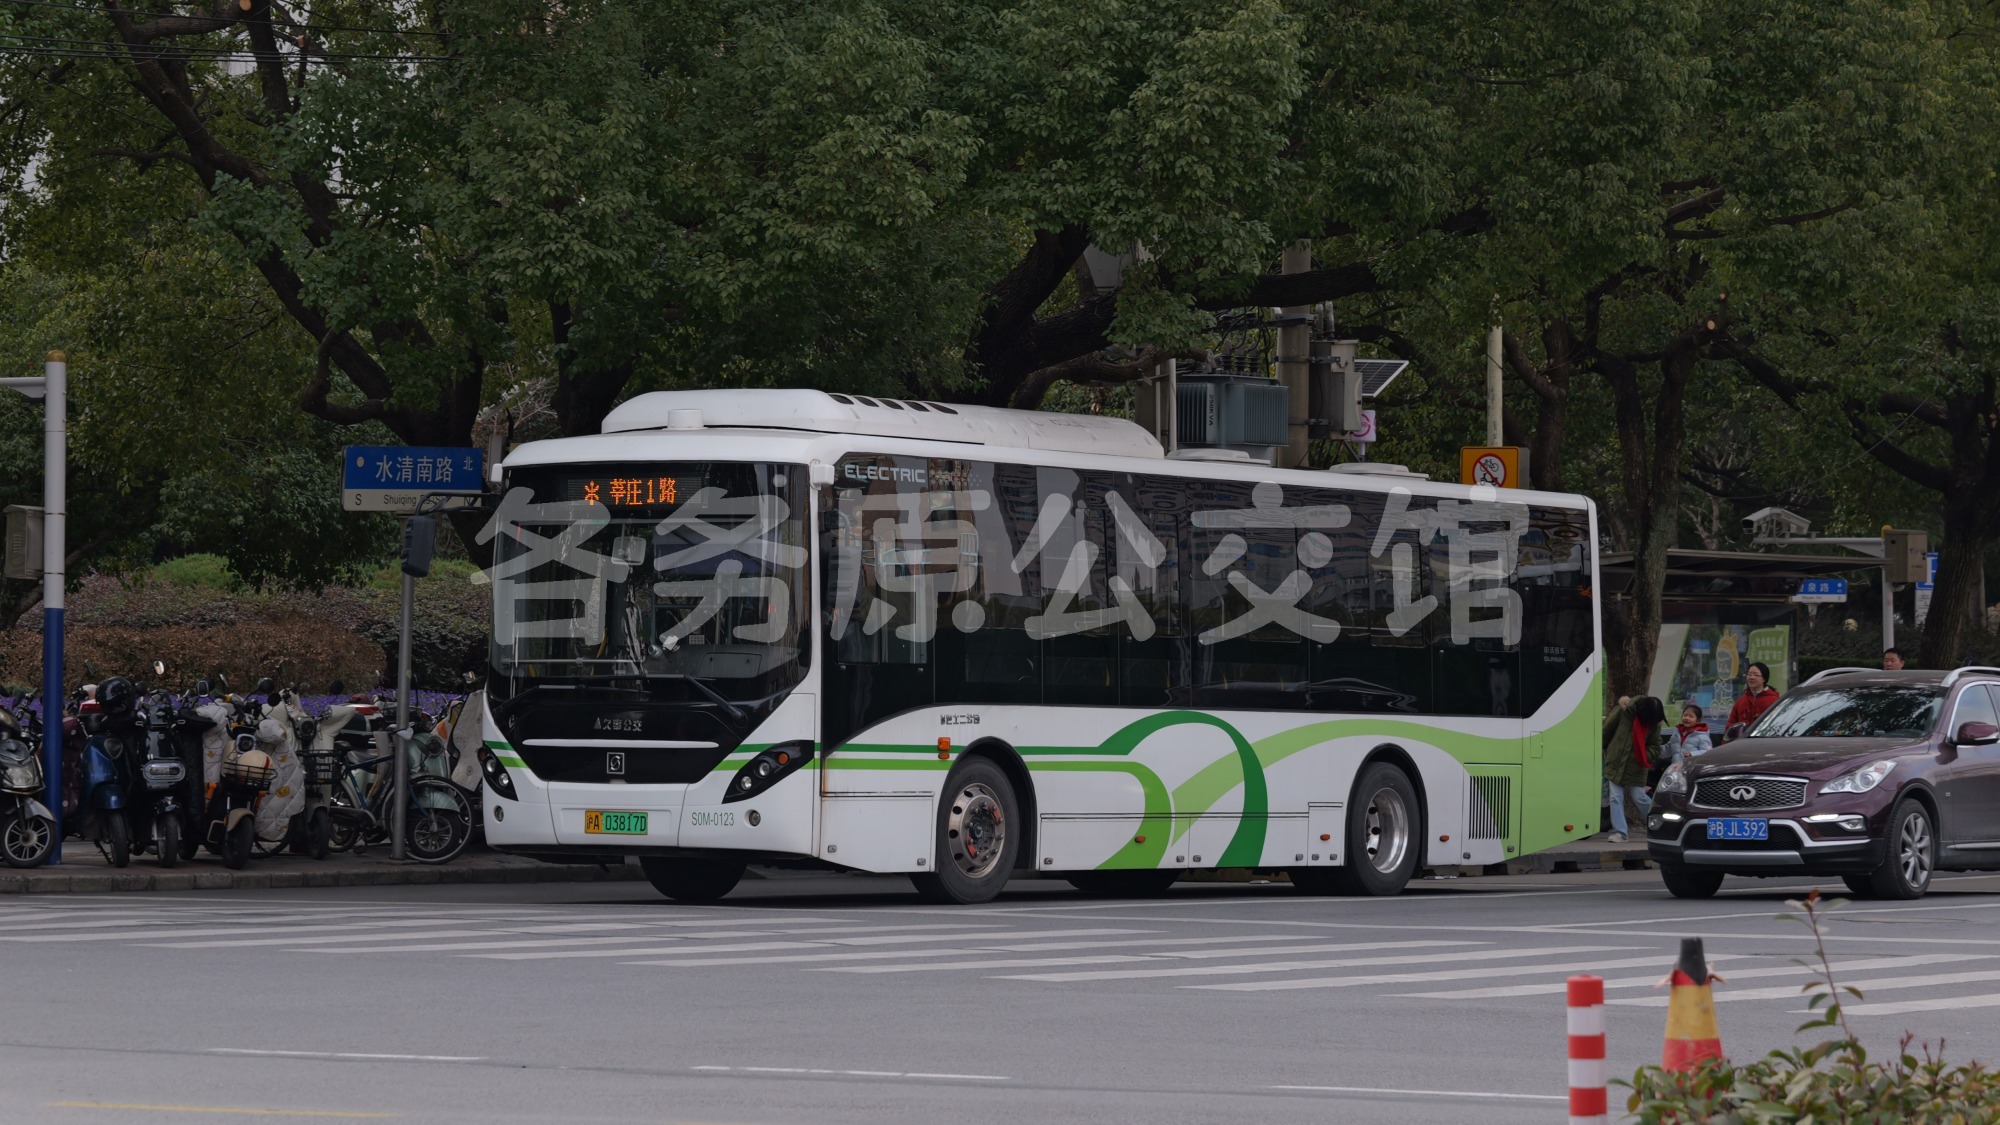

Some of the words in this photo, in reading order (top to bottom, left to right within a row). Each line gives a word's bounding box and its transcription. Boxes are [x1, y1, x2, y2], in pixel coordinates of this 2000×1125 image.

[375, 454, 454, 483] 水清南路
[462, 456, 474, 471] 北
[845, 464, 926, 482] ELECTRIC
[354, 493, 362, 506] S
[383, 494, 417, 507] Shuiqing
[609, 477, 677, 506] 莘庄1路
[602, 718, 643, 732] 久事公交
